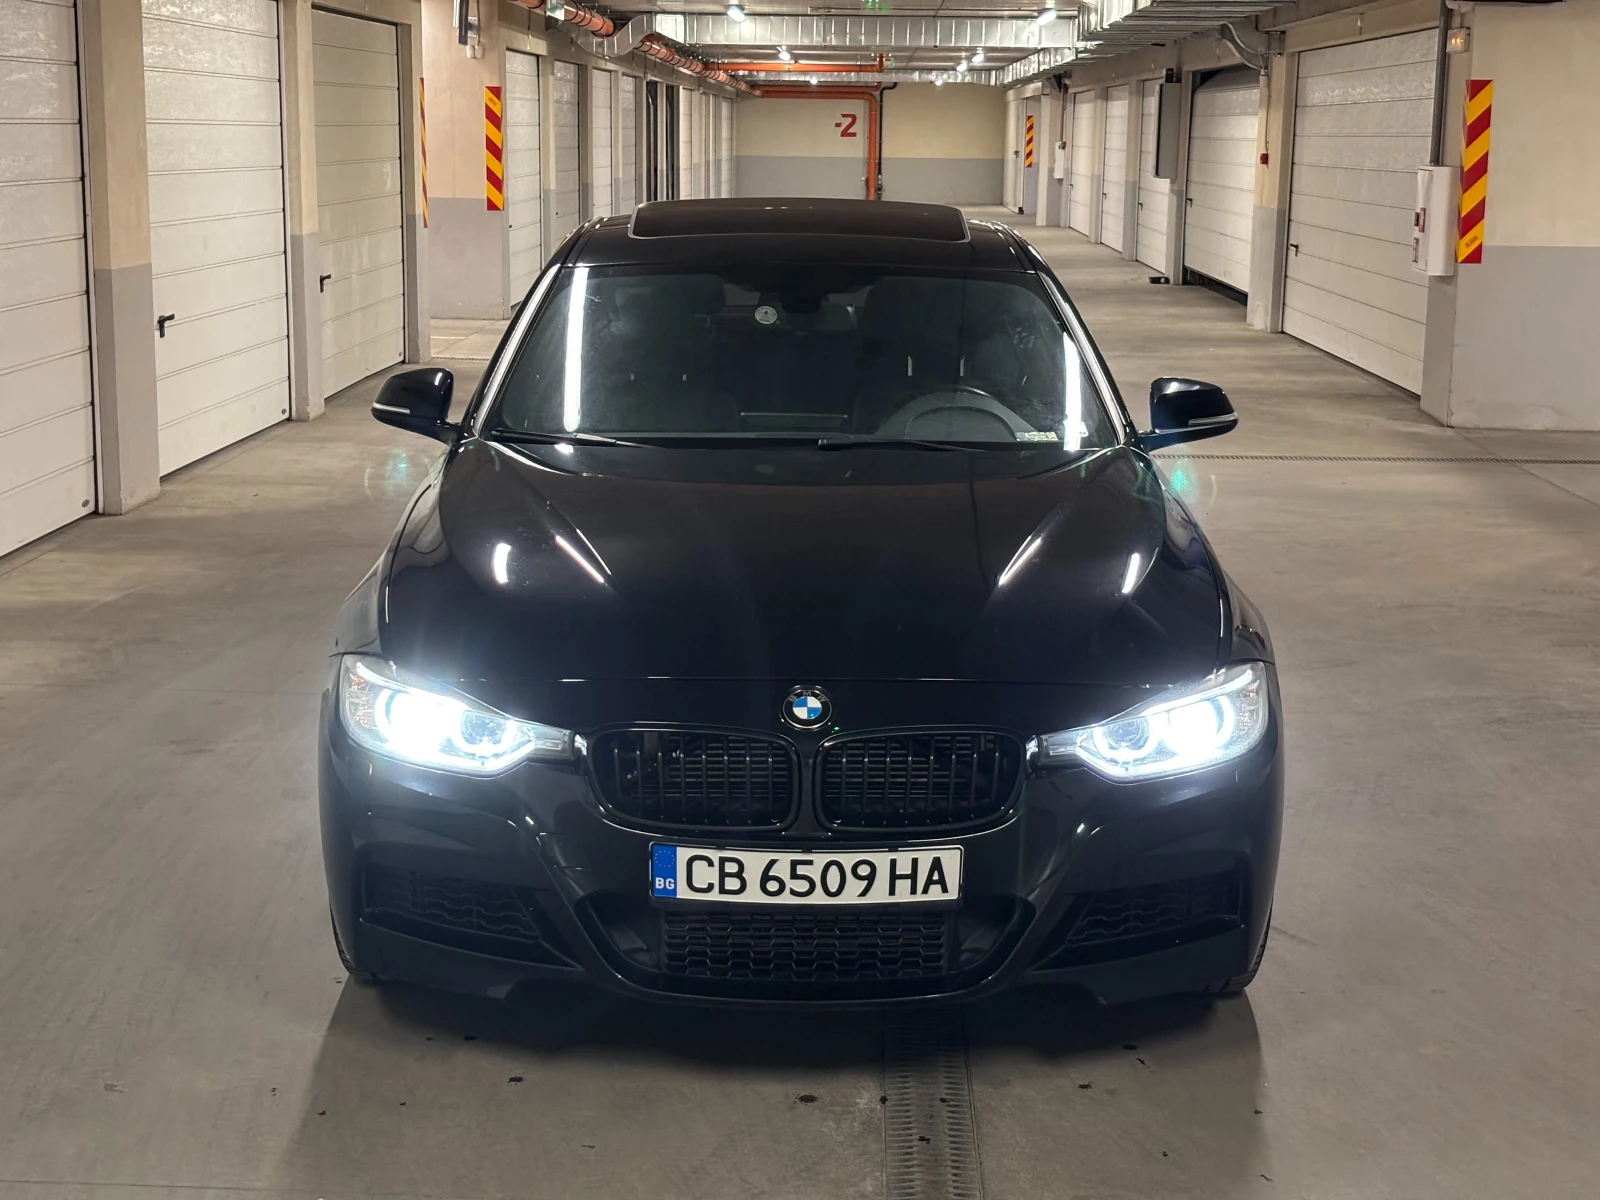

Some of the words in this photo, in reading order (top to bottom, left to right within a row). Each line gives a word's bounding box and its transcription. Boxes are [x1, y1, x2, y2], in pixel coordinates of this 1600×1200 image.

[834, 113, 857, 138] -2
[788, 690, 828, 702] BMW
[655, 877, 675, 890] BG
[685, 854, 747, 895] CB
[759, 858, 877, 898] 6509
[888, 856, 949, 896] HA
